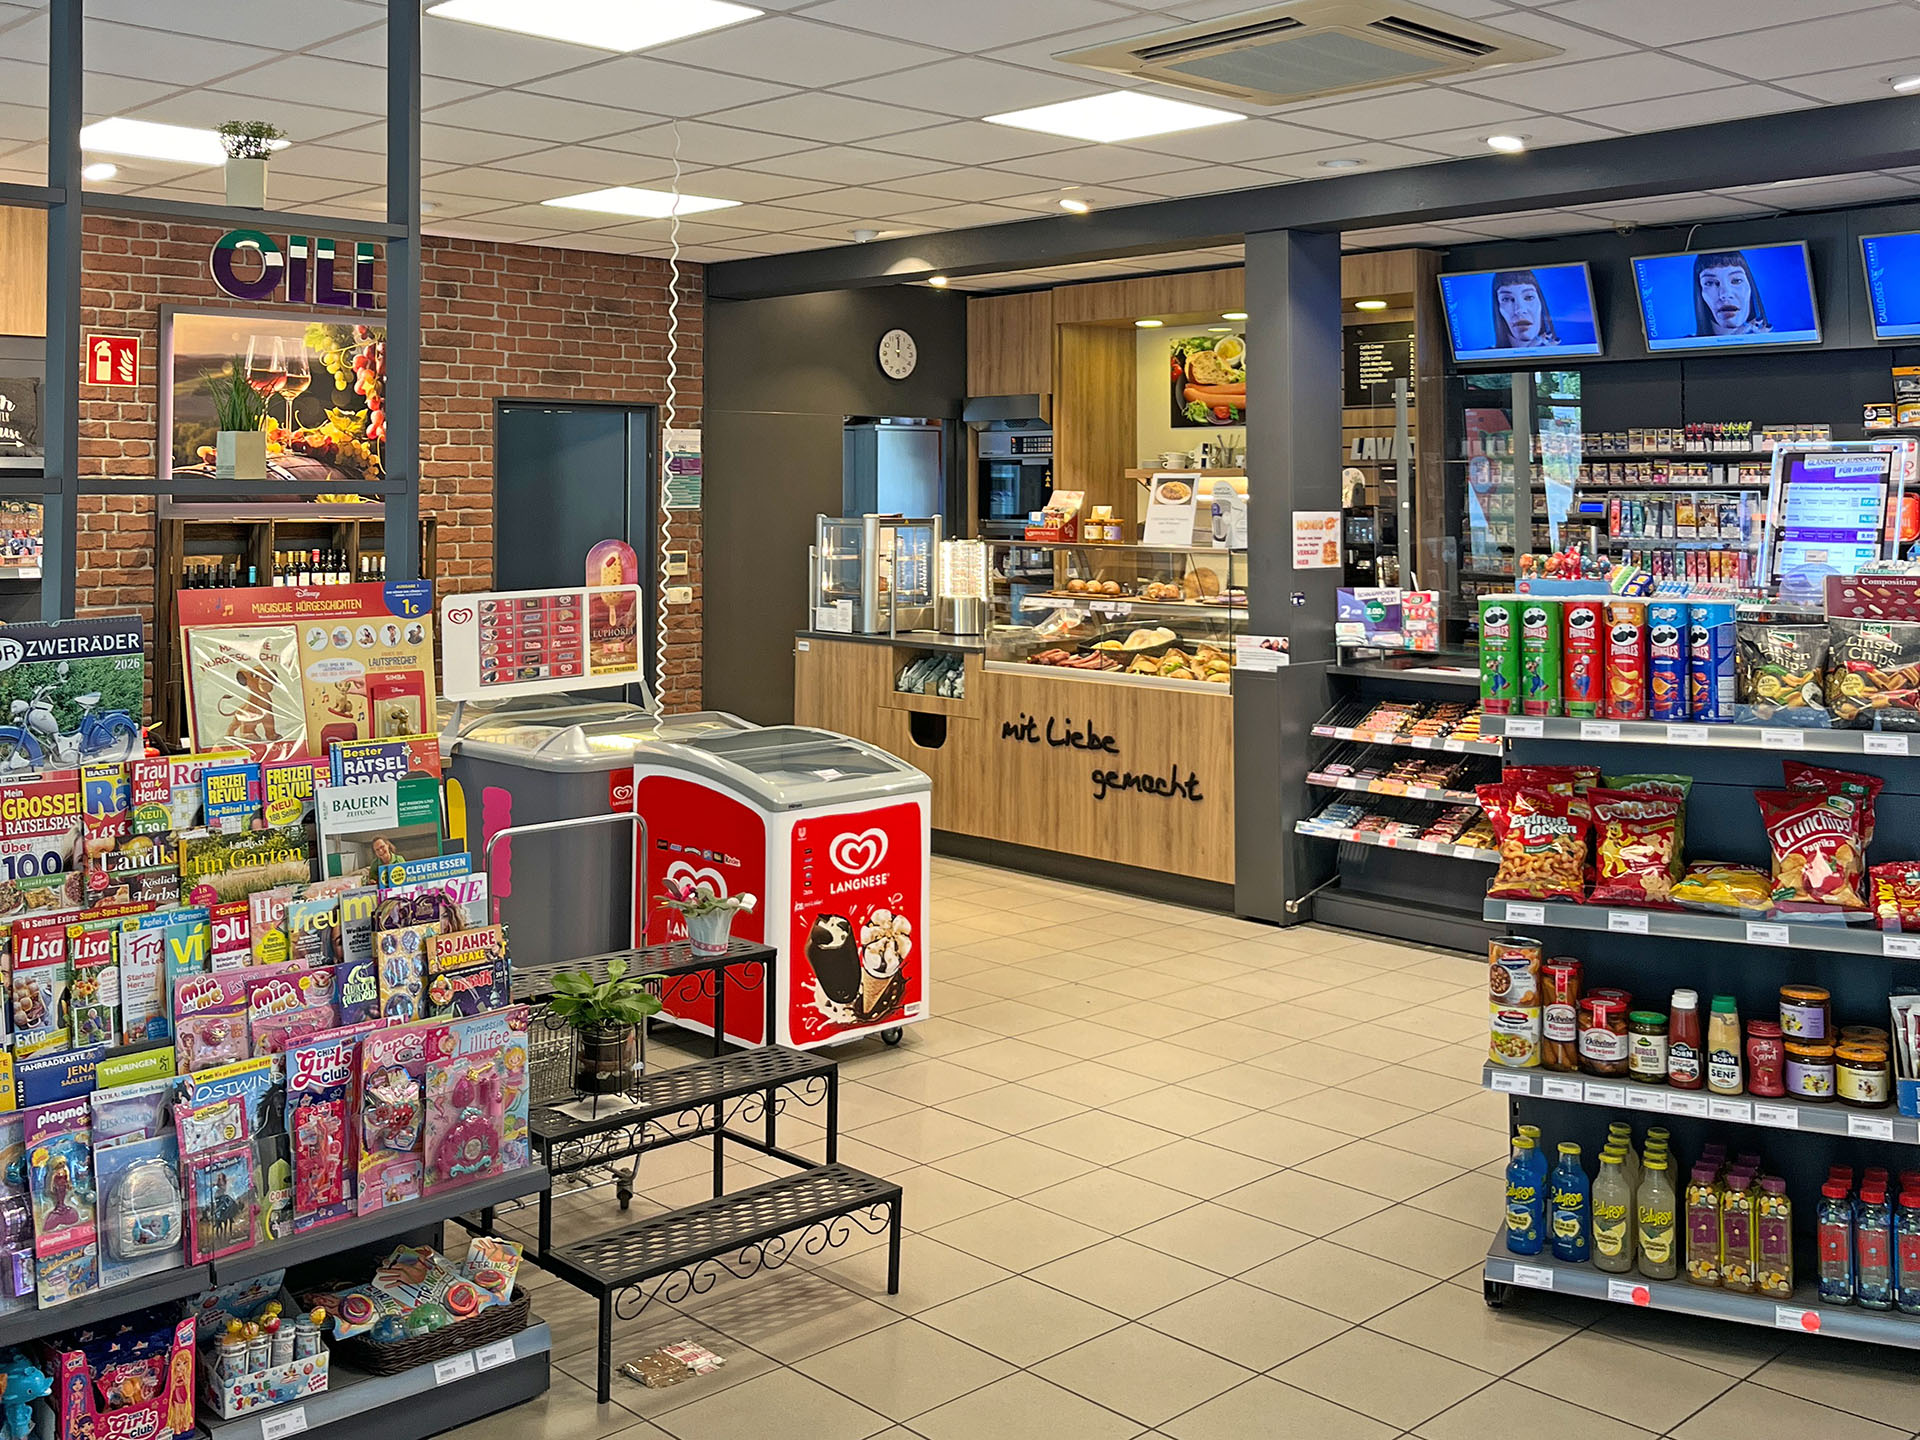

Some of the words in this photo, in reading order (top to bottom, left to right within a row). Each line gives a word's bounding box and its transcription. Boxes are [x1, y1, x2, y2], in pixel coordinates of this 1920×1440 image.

[210, 229, 374, 308] OIL!
[1861, 577, 1918, 587] Composition
[252, 602, 293, 615] MAGISCHE
[295, 598, 362, 612] HÖRGESCHICHTEN
[1340, 605, 1351, 618] 2
[1483, 624, 1510, 639] PRINGLES
[1523, 625, 1549, 639] PRINGLES
[1569, 626, 1596, 639] PRINGLES
[25, 632, 140, 657] ZWEIRÄDER
[1611, 643, 1639, 657] PRINGLES
[1651, 645, 1680, 660] PRINGLES
[1757, 642, 1811, 662] Linsen
[1845, 637, 1902, 656] Linsen
[114, 658, 140, 671] 2026
[368, 655, 417, 667] LAUTSPRECHER
[1848, 647, 1896, 669] Chips
[384, 673, 406, 681] SIMBA
[1002, 712, 1040, 743] mit
[1047, 716, 1120, 754] Liebe
[343, 747, 383, 759] Bester
[86, 768, 119, 778] BASTEI
[134, 763, 168, 781] Frau
[343, 756, 406, 775] RÄTSEL
[207, 773, 246, 791] FREIZEIT
[266, 765, 312, 785] FREIZEIT
[1091, 764, 1204, 801] gemacht
[4, 789, 24, 798] Mein
[140, 781, 155, 790] von
[267, 780, 313, 802] REVUE
[135, 788, 169, 803] Heute
[208, 786, 247, 805] REVUE
[332, 795, 389, 813] BAUERN
[139, 808, 163, 820] NEU!
[271, 799, 294, 813] NEU!
[281, 807, 301, 820] Seiten
[346, 809, 376, 818] ZEITUNG
[1524, 822, 1577, 840] Locken
[1775, 811, 1850, 848] Crunchips
[2, 842, 32, 854] Über
[1802, 839, 1836, 854] Paprika
[2, 851, 62, 880] 100
[192, 855, 223, 875] Im
[229, 846, 303, 872] Garten
[406, 863, 437, 875] CLEVER
[438, 858, 466, 870] ESSEN
[830, 874, 888, 895] LANGNESE
[21, 920, 31, 930] 16
[32, 917, 57, 929] Seiten
[57, 914, 79, 925] Extra:
[20, 936, 64, 963] Lisa
[74, 938, 110, 960] Lisa
[436, 940, 452, 955] 50
[455, 931, 496, 952] JAHRE
[441, 949, 485, 968] ABRAFAXE
[126, 972, 155, 982] Starkes
[127, 981, 145, 990] Herz
[466, 1020, 504, 1035] Prinzessin
[15, 1029, 47, 1049] Extra
[459, 1030, 510, 1056] Lillifee
[316, 1047, 336, 1058] CHIX
[1671, 1048, 1693, 1058] BORN
[1711, 1054, 1735, 1064] BORN
[20, 1053, 86, 1073] FAHRRADKARTE
[67, 1063, 96, 1079] JENA
[103, 1058, 157, 1077] THÜRINGEN
[294, 1046, 351, 1085] Girls
[1669, 1060, 1695, 1068] KETCHUP
[1711, 1068, 1737, 1079] SENF
[196, 1072, 285, 1101] OSTWIND
[93, 1091, 120, 1101] EXTRA:
[1593, 1199, 1626, 1219] Calypso
[1639, 1205, 1673, 1226] Calypso
[103, 1269, 130, 1284] FROZEN
[107, 1409, 158, 1437] Girls
